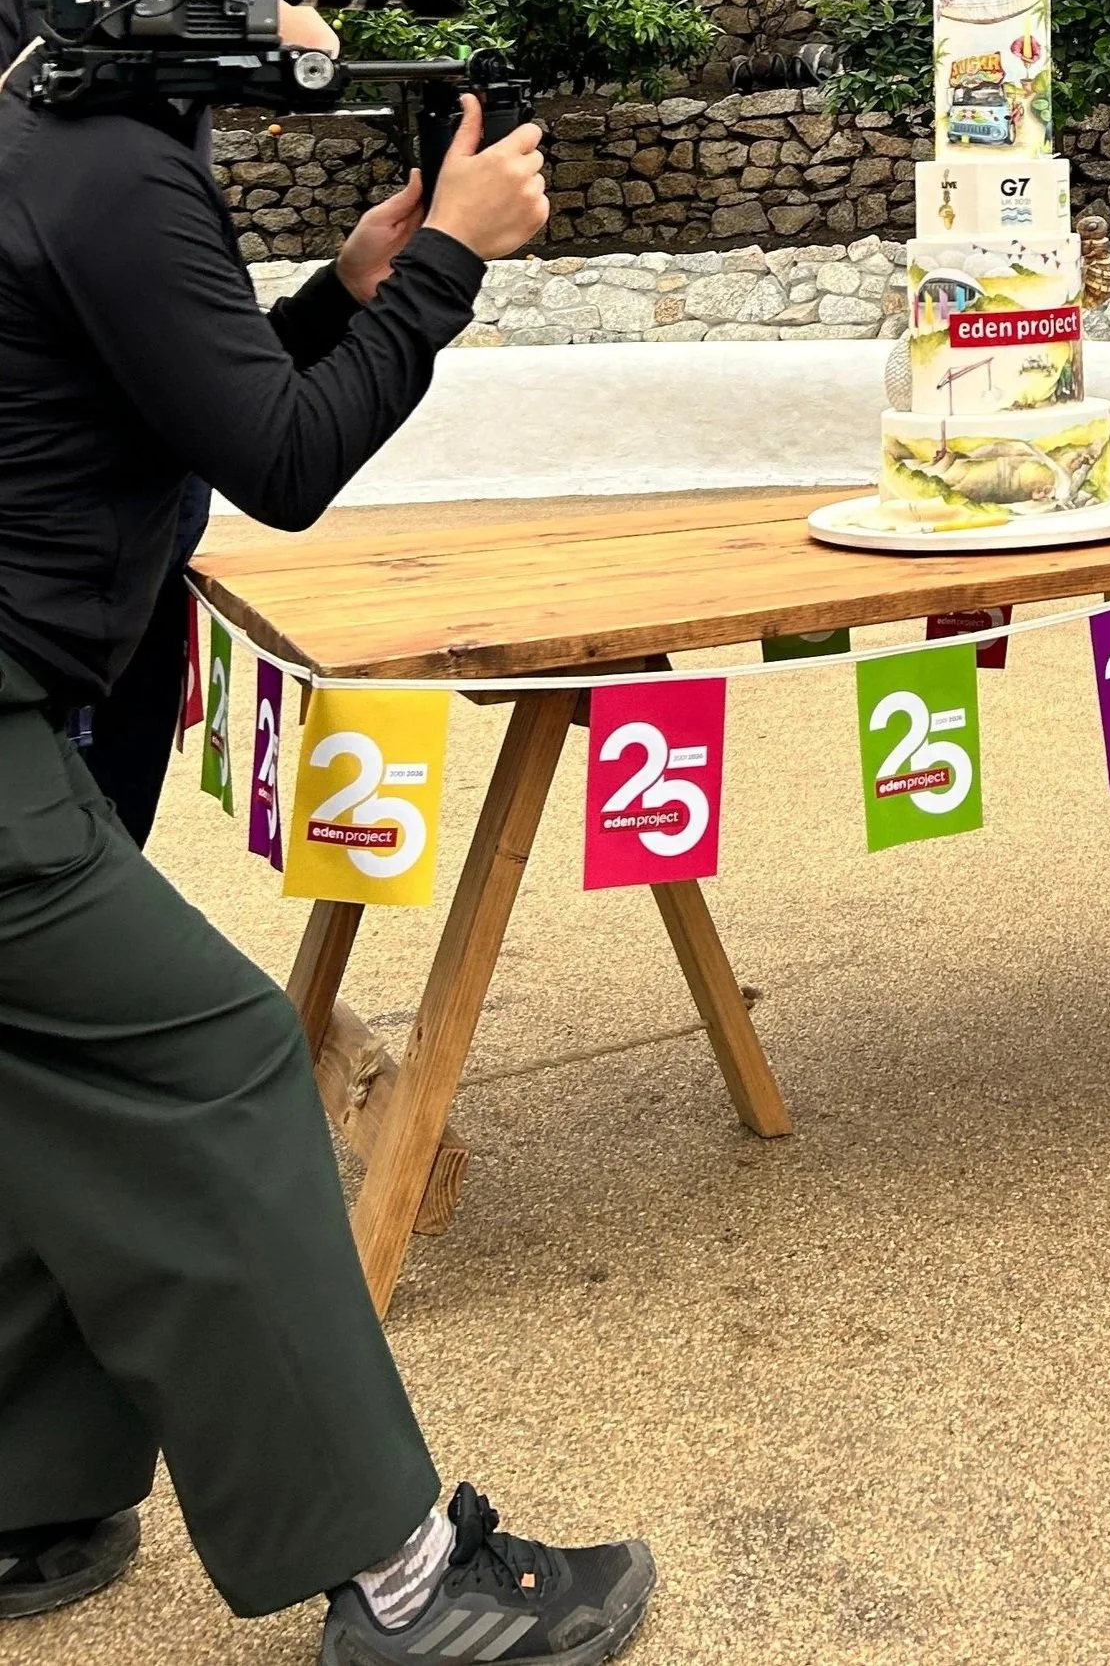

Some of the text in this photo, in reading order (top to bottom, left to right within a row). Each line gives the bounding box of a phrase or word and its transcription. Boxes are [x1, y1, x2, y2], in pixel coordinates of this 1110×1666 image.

[941, 181, 958, 190] LIVE
[1001, 178, 1031, 197] G7
[958, 312, 1077, 340] eden project
[869, 690, 973, 815] 25
[599, 721, 709, 857] 25
[879, 771, 946, 794] eden project
[309, 731, 428, 878] 25
[604, 812, 679, 829] eden project
[312, 826, 393, 844] eden project
